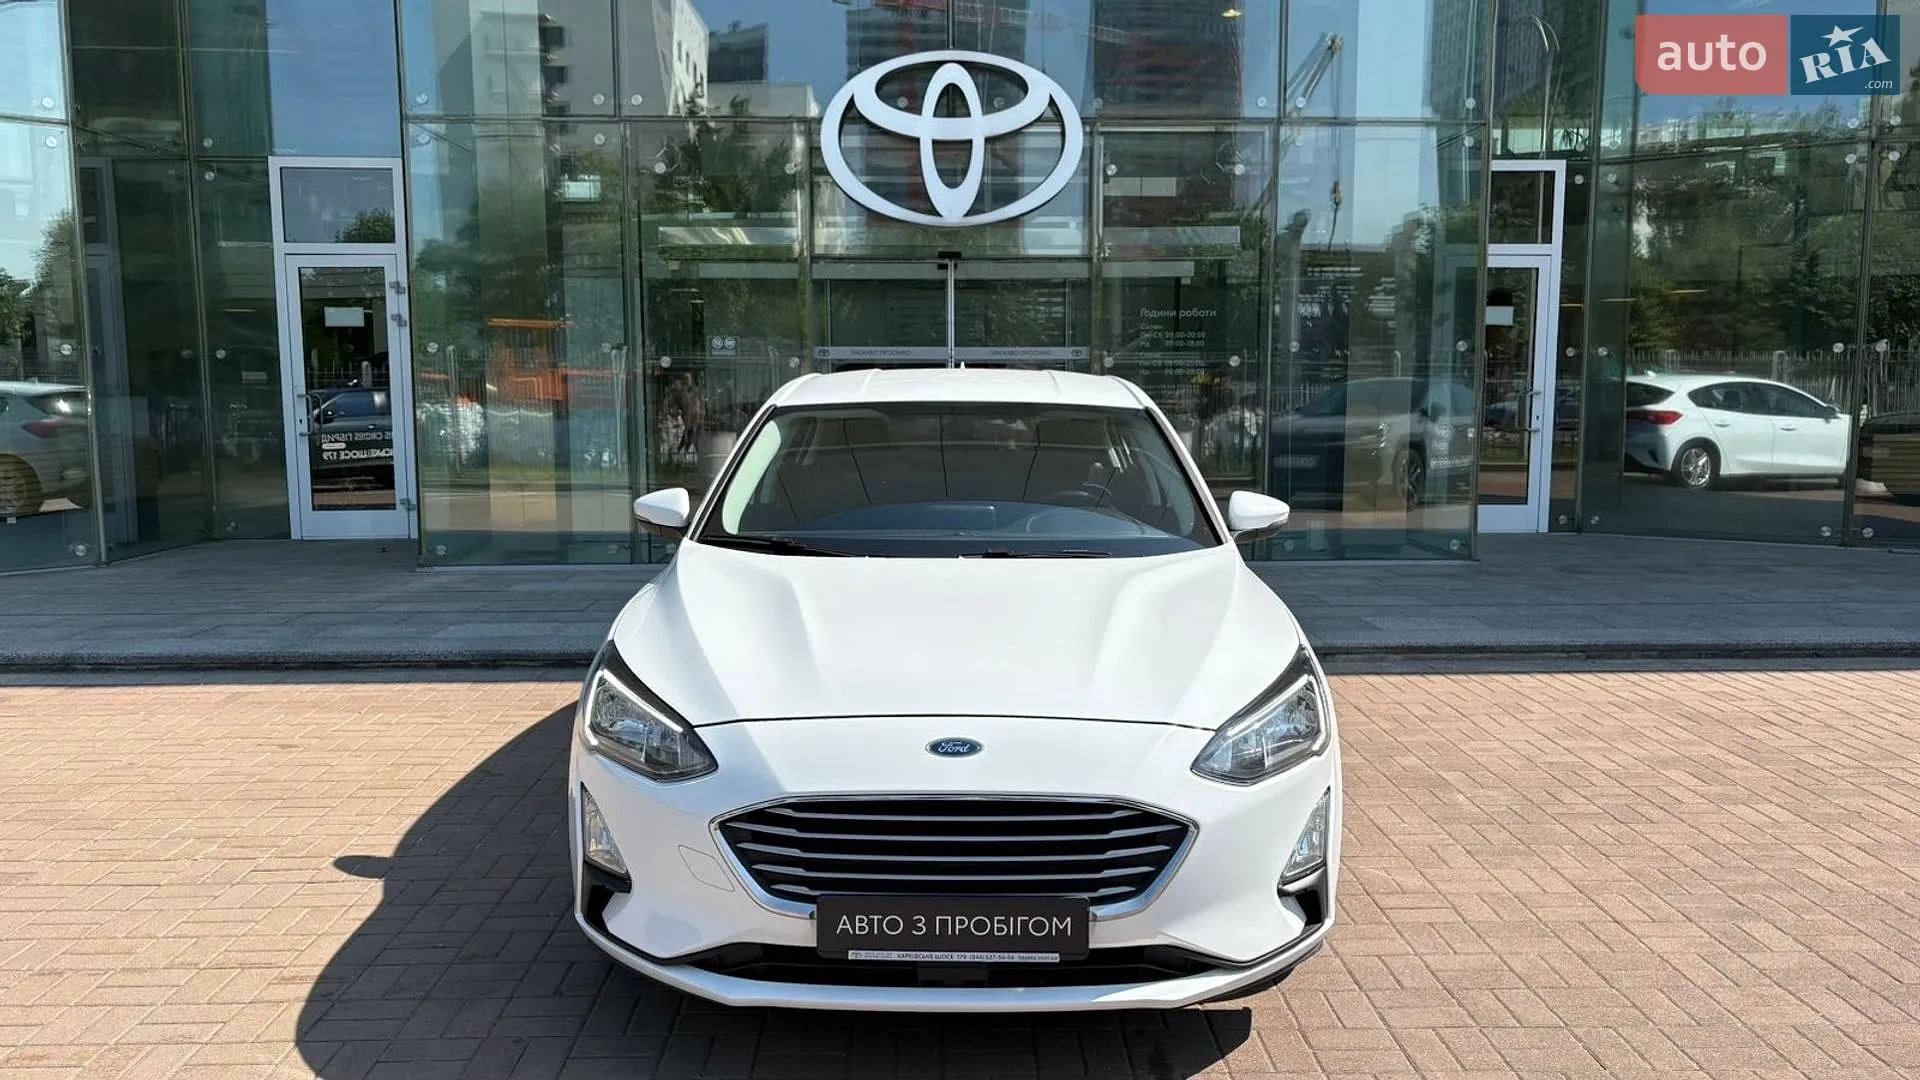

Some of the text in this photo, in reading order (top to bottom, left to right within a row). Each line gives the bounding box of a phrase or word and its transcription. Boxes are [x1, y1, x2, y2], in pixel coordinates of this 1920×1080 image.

[1140, 307, 1217, 319] Години роботи
[938, 741, 970, 753] Ford
[836, 915, 1072, 937] АВТО З ПРОБІГОМ
